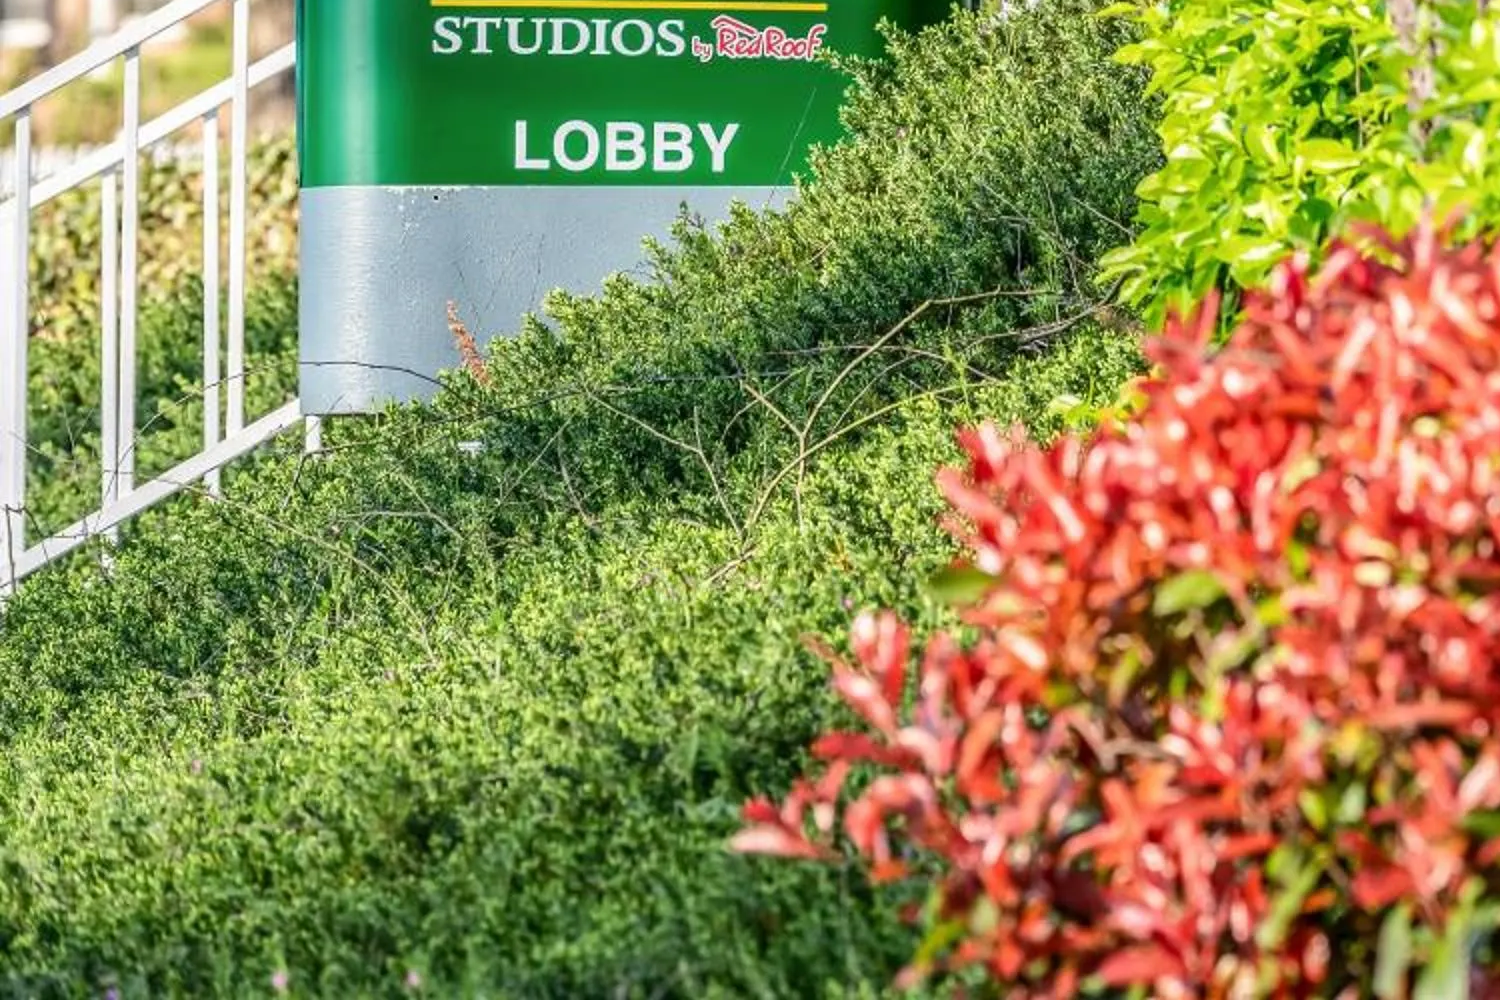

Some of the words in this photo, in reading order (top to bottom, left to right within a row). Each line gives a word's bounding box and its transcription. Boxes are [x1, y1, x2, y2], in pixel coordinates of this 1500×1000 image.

[431, 16, 686, 57] STUDIOS
[692, 35, 712, 62] by
[514, 119, 740, 173] LOBBY
